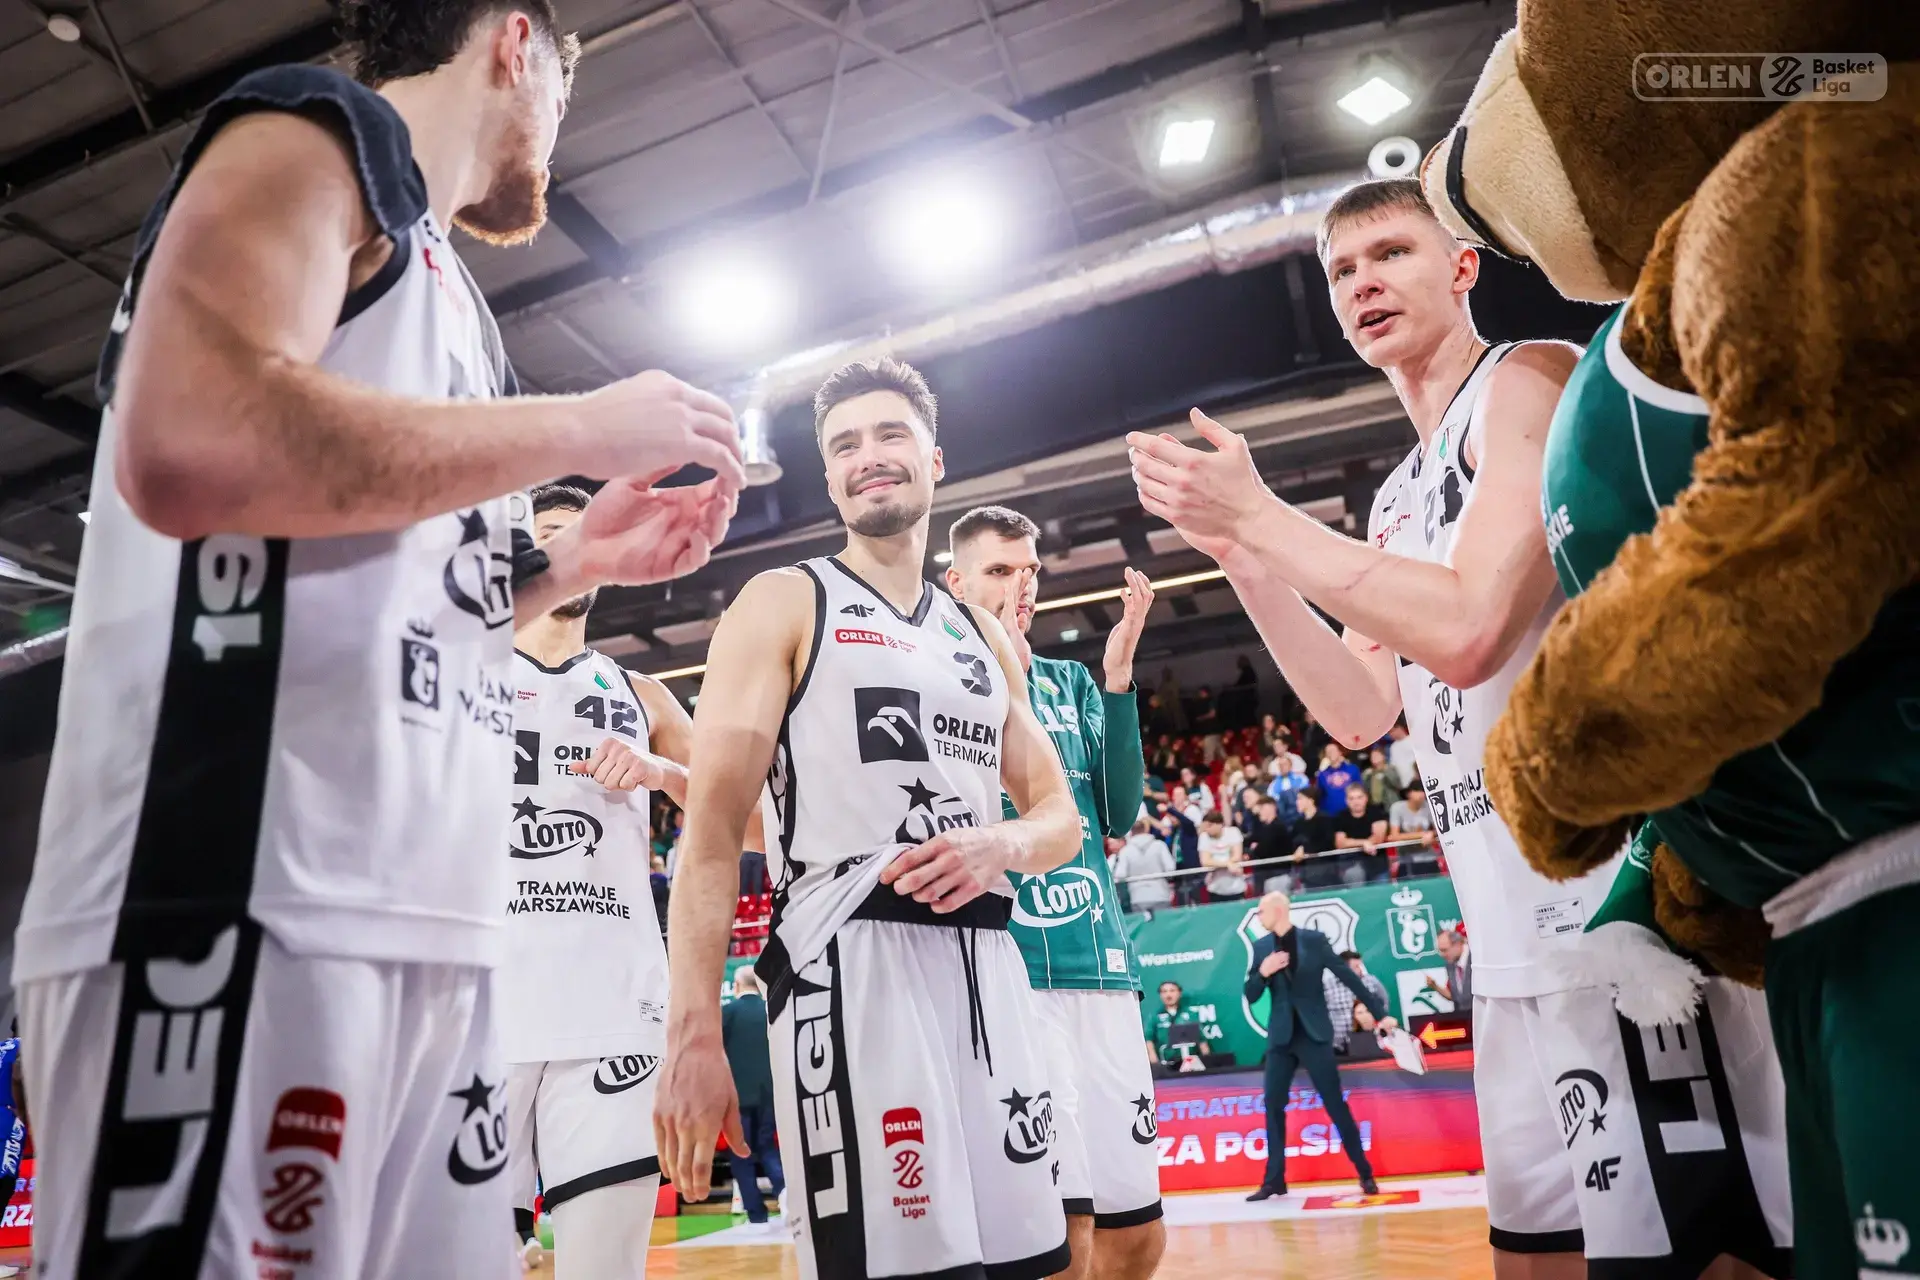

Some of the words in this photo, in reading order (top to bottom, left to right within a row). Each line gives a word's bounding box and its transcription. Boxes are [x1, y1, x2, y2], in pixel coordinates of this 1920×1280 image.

[839, 631, 881, 643] ORLEN
[953, 651, 993, 697] 3
[574, 695, 638, 739] 42
[933, 713, 997, 748] ORLEN
[554, 744, 592, 762] ORL
[934, 739, 998, 770] TERMIKA
[521, 820, 586, 849] LOTTO
[517, 881, 617, 901] TRAMWAJE
[1031, 879, 1092, 915] LOTTO
[885, 1121, 921, 1133] ORLEN
[1585, 1156, 1622, 1192] 4F
[893, 1195, 931, 1207] Basket
[902, 1207, 926, 1219] Liga
